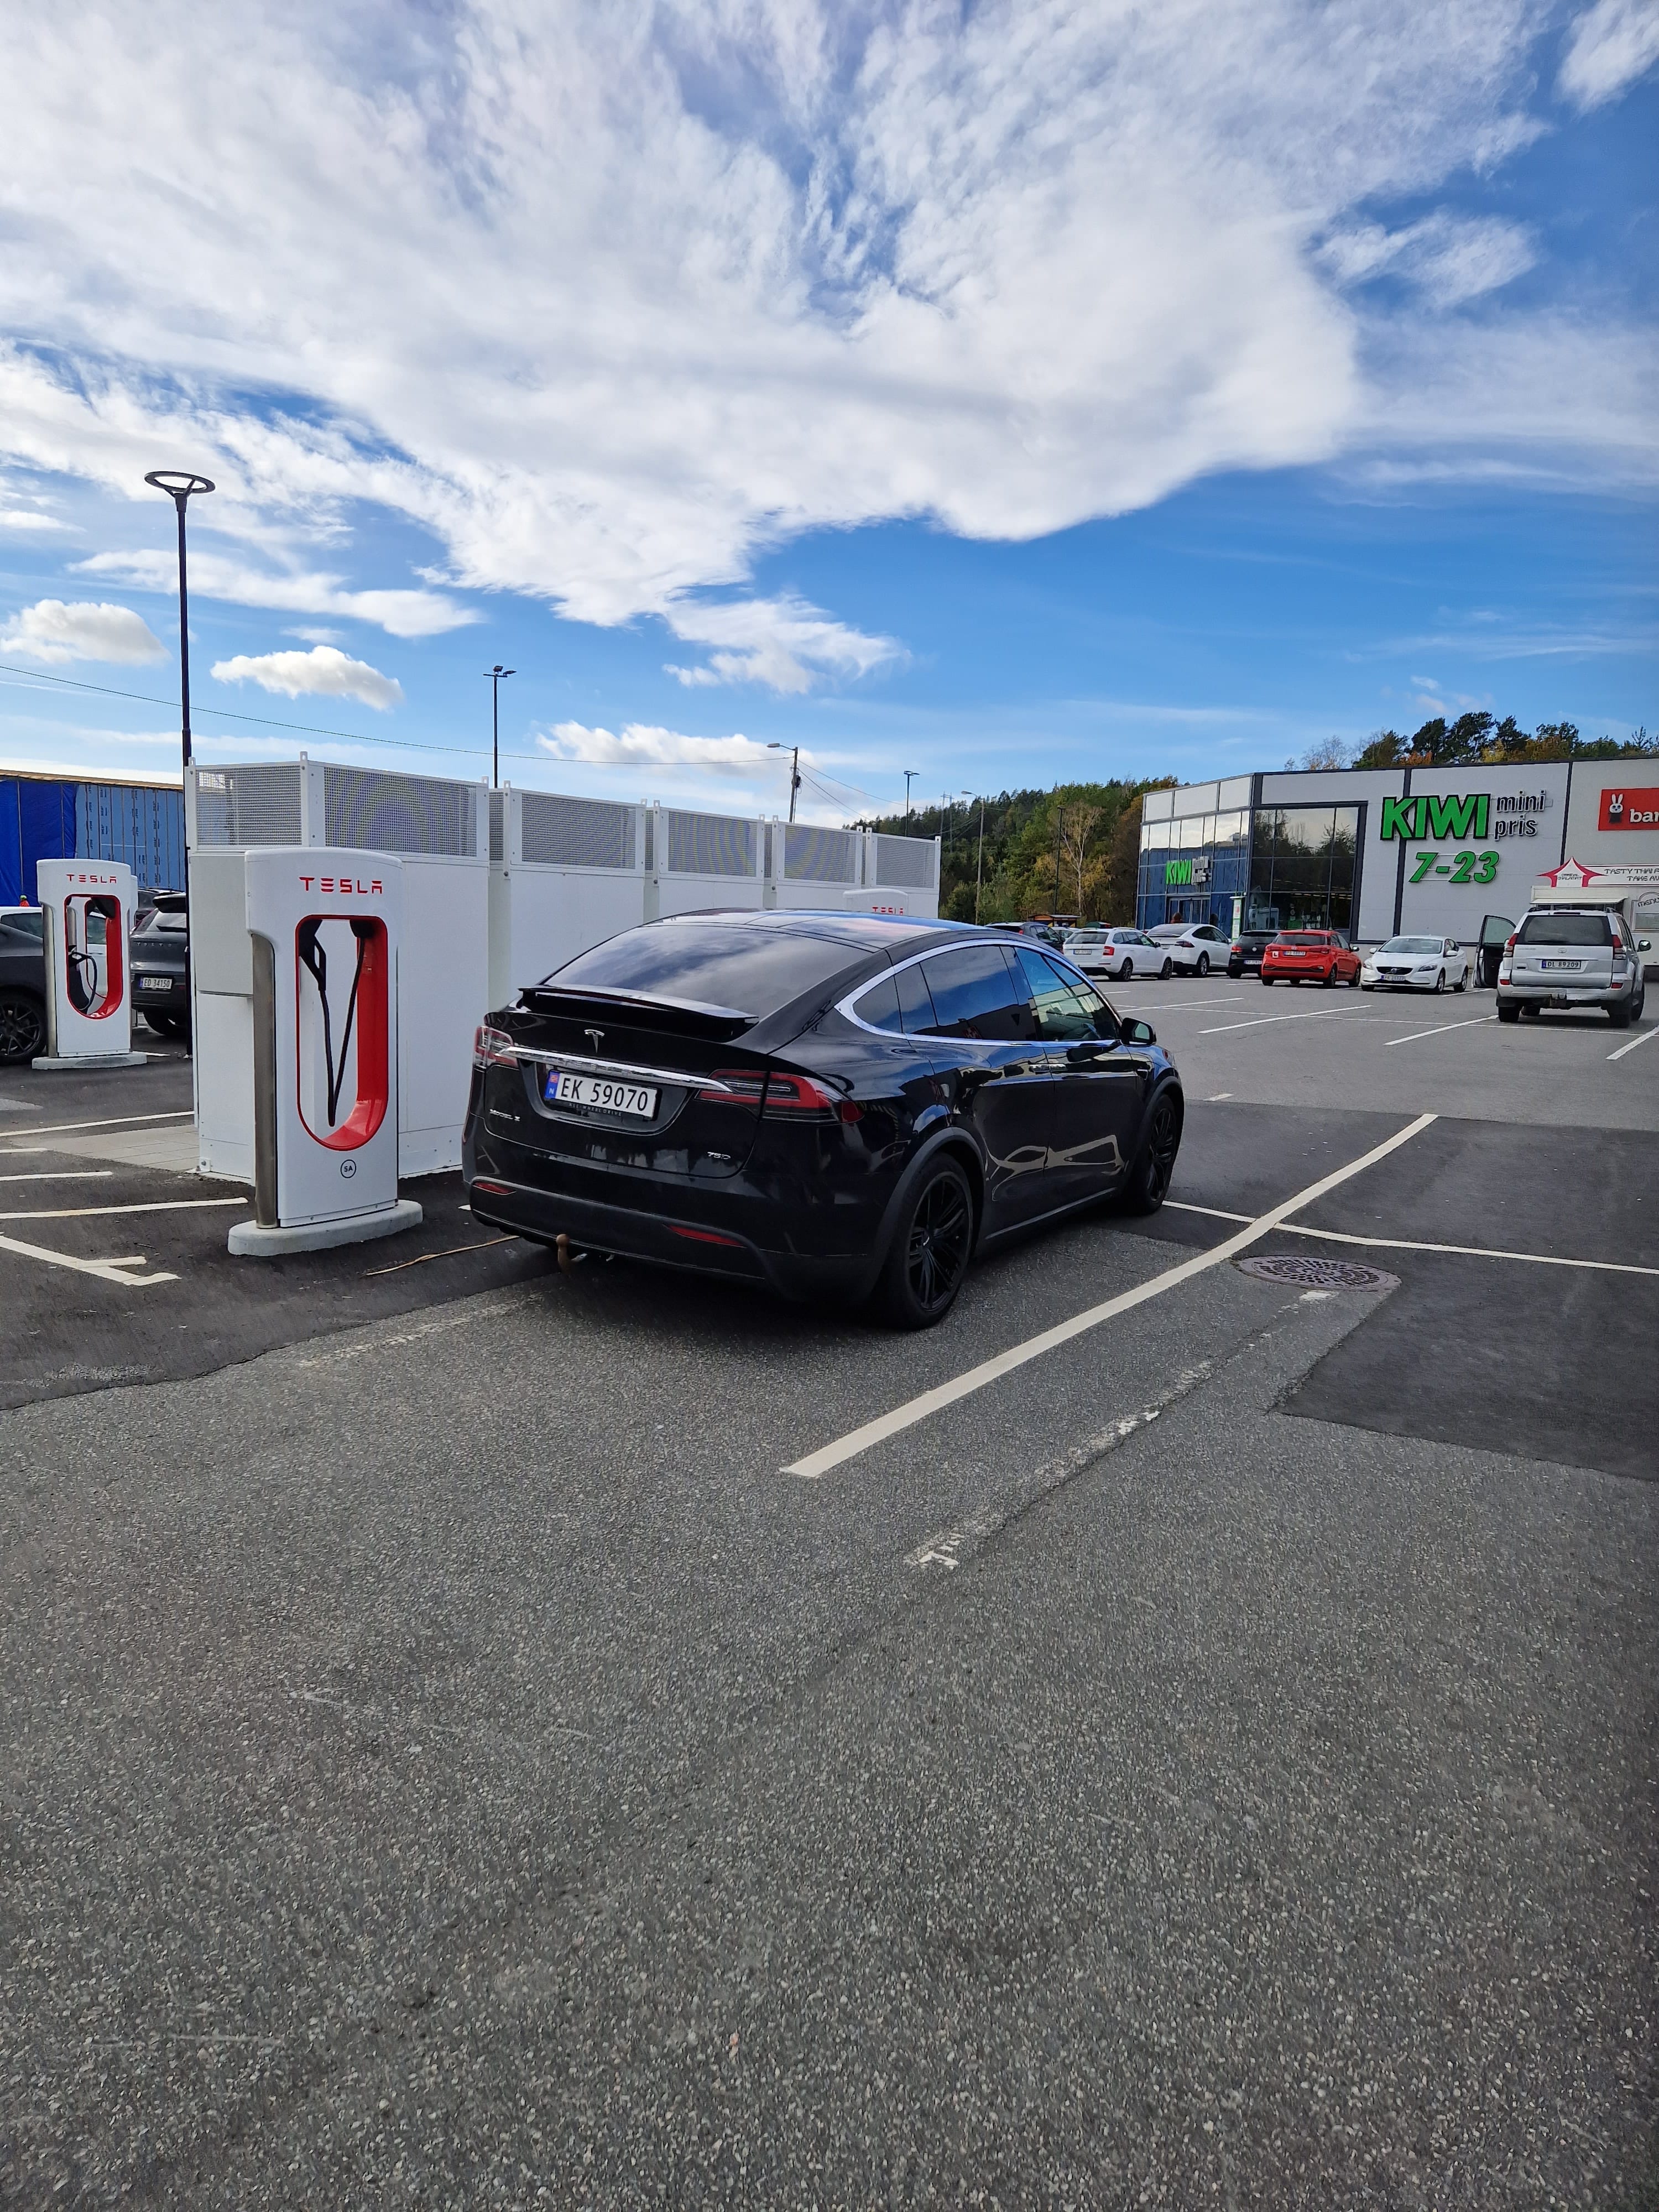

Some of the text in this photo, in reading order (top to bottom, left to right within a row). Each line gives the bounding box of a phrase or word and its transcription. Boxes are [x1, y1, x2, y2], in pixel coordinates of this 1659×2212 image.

[1496, 790, 1547, 812] mini
[1380, 794, 1491, 841] KIWI
[1494, 815, 1538, 841] pris
[66, 874, 117, 884] TESLA
[1166, 860, 1192, 885] KIWI
[1408, 851, 1500, 884] 7-23
[299, 877, 382, 894] TESLA
[153, 979, 170, 988] 34150
[561, 1077, 648, 1112] EK 59070
